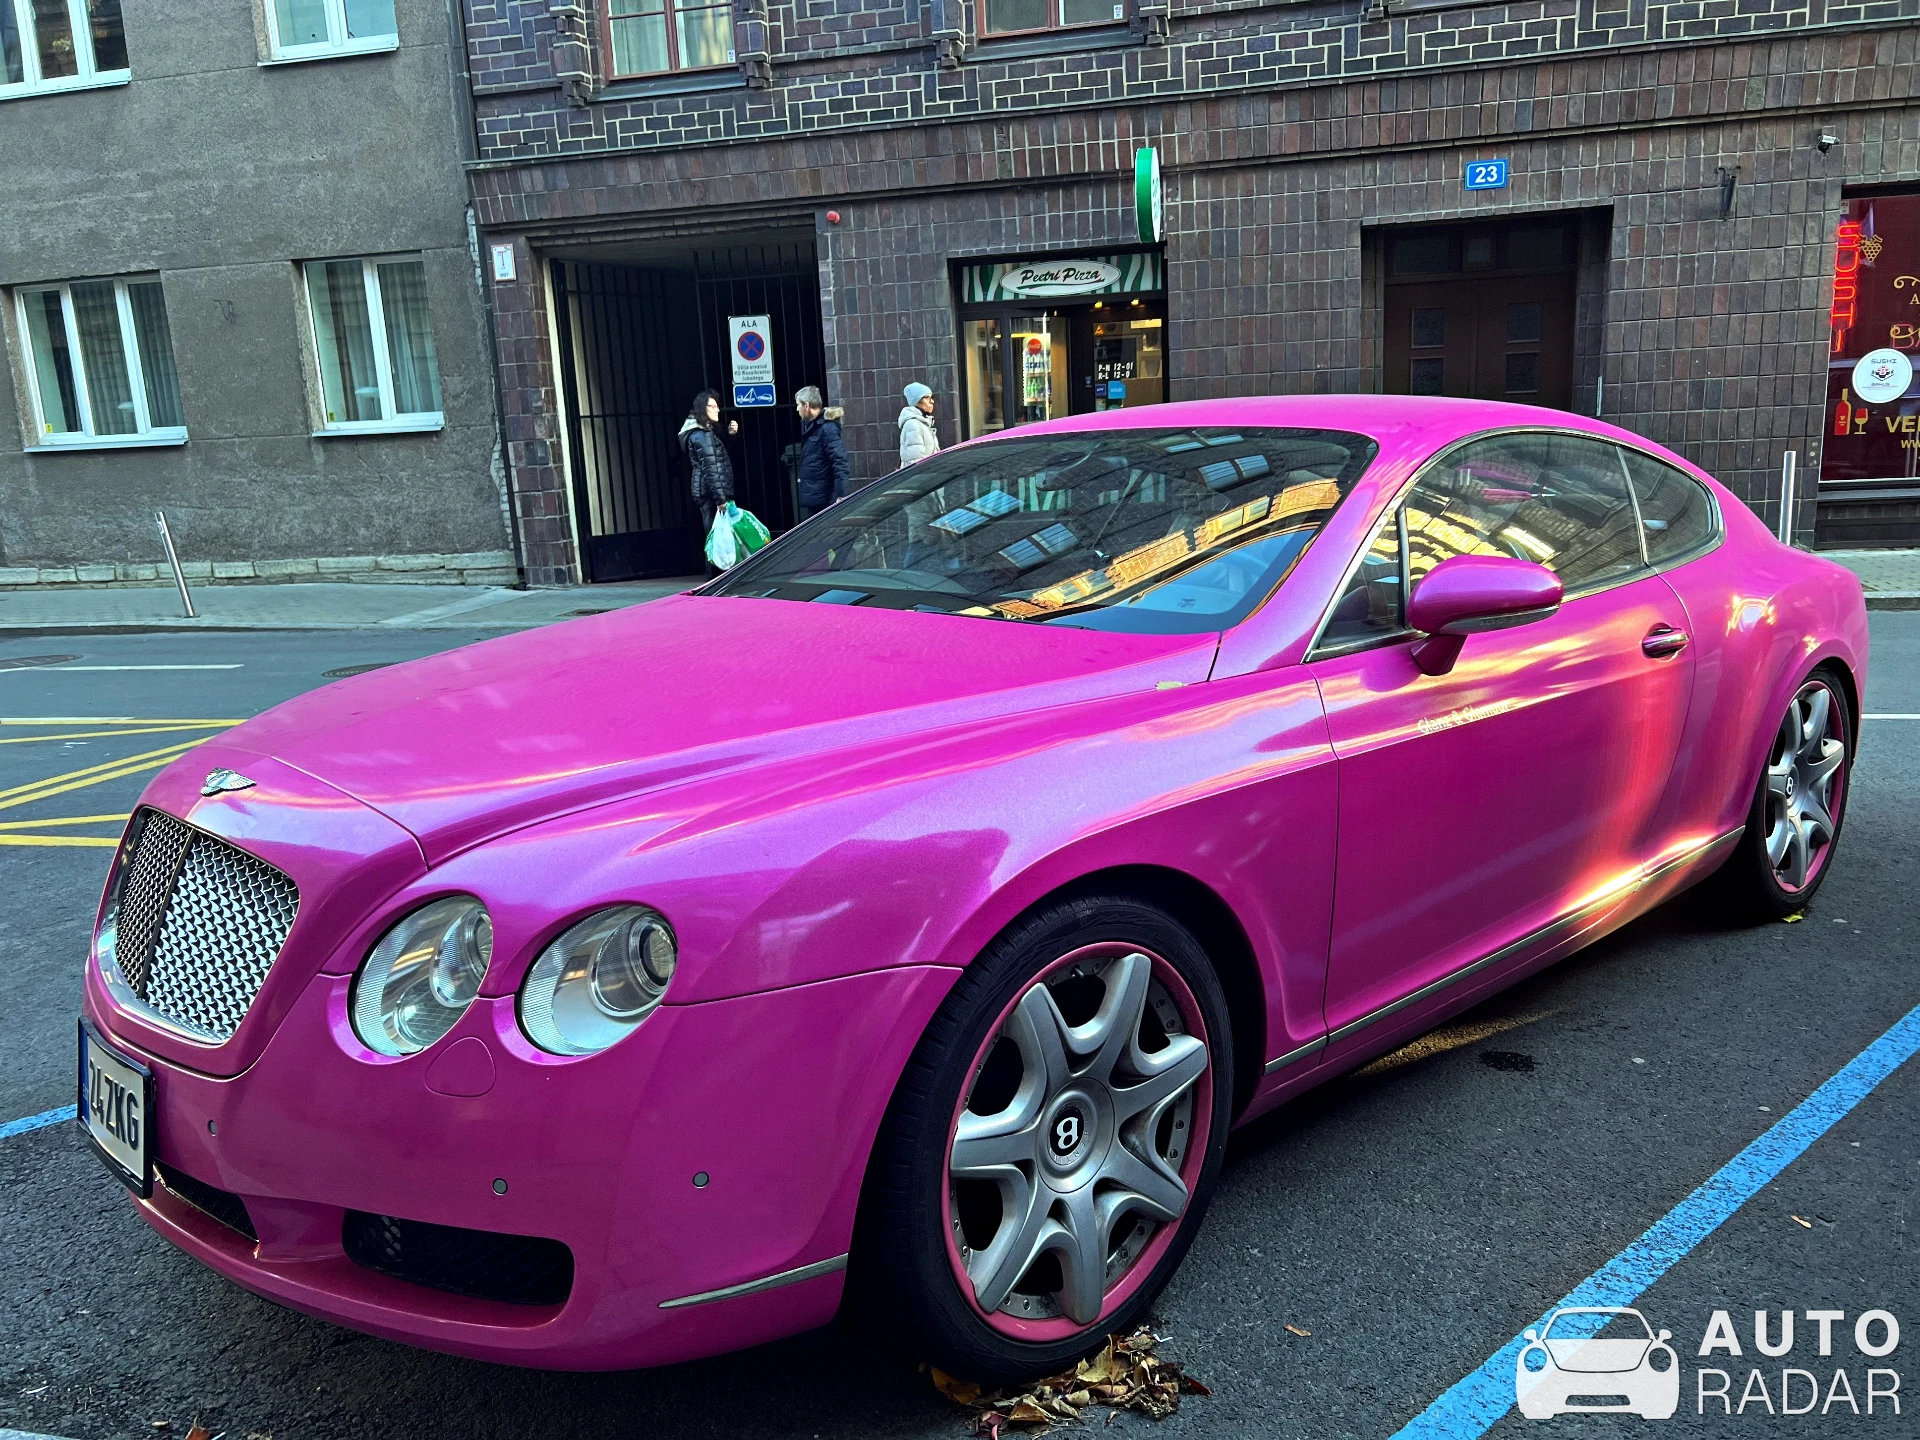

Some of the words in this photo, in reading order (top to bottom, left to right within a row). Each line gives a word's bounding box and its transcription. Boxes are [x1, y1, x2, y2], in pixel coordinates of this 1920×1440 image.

[1475, 166, 1498, 183] 23
[1020, 269, 1061, 285] Peetri
[1062, 267, 1101, 282] Pizza
[1831, 223, 1861, 353] SUSHI
[741, 320, 758, 328] ALA
